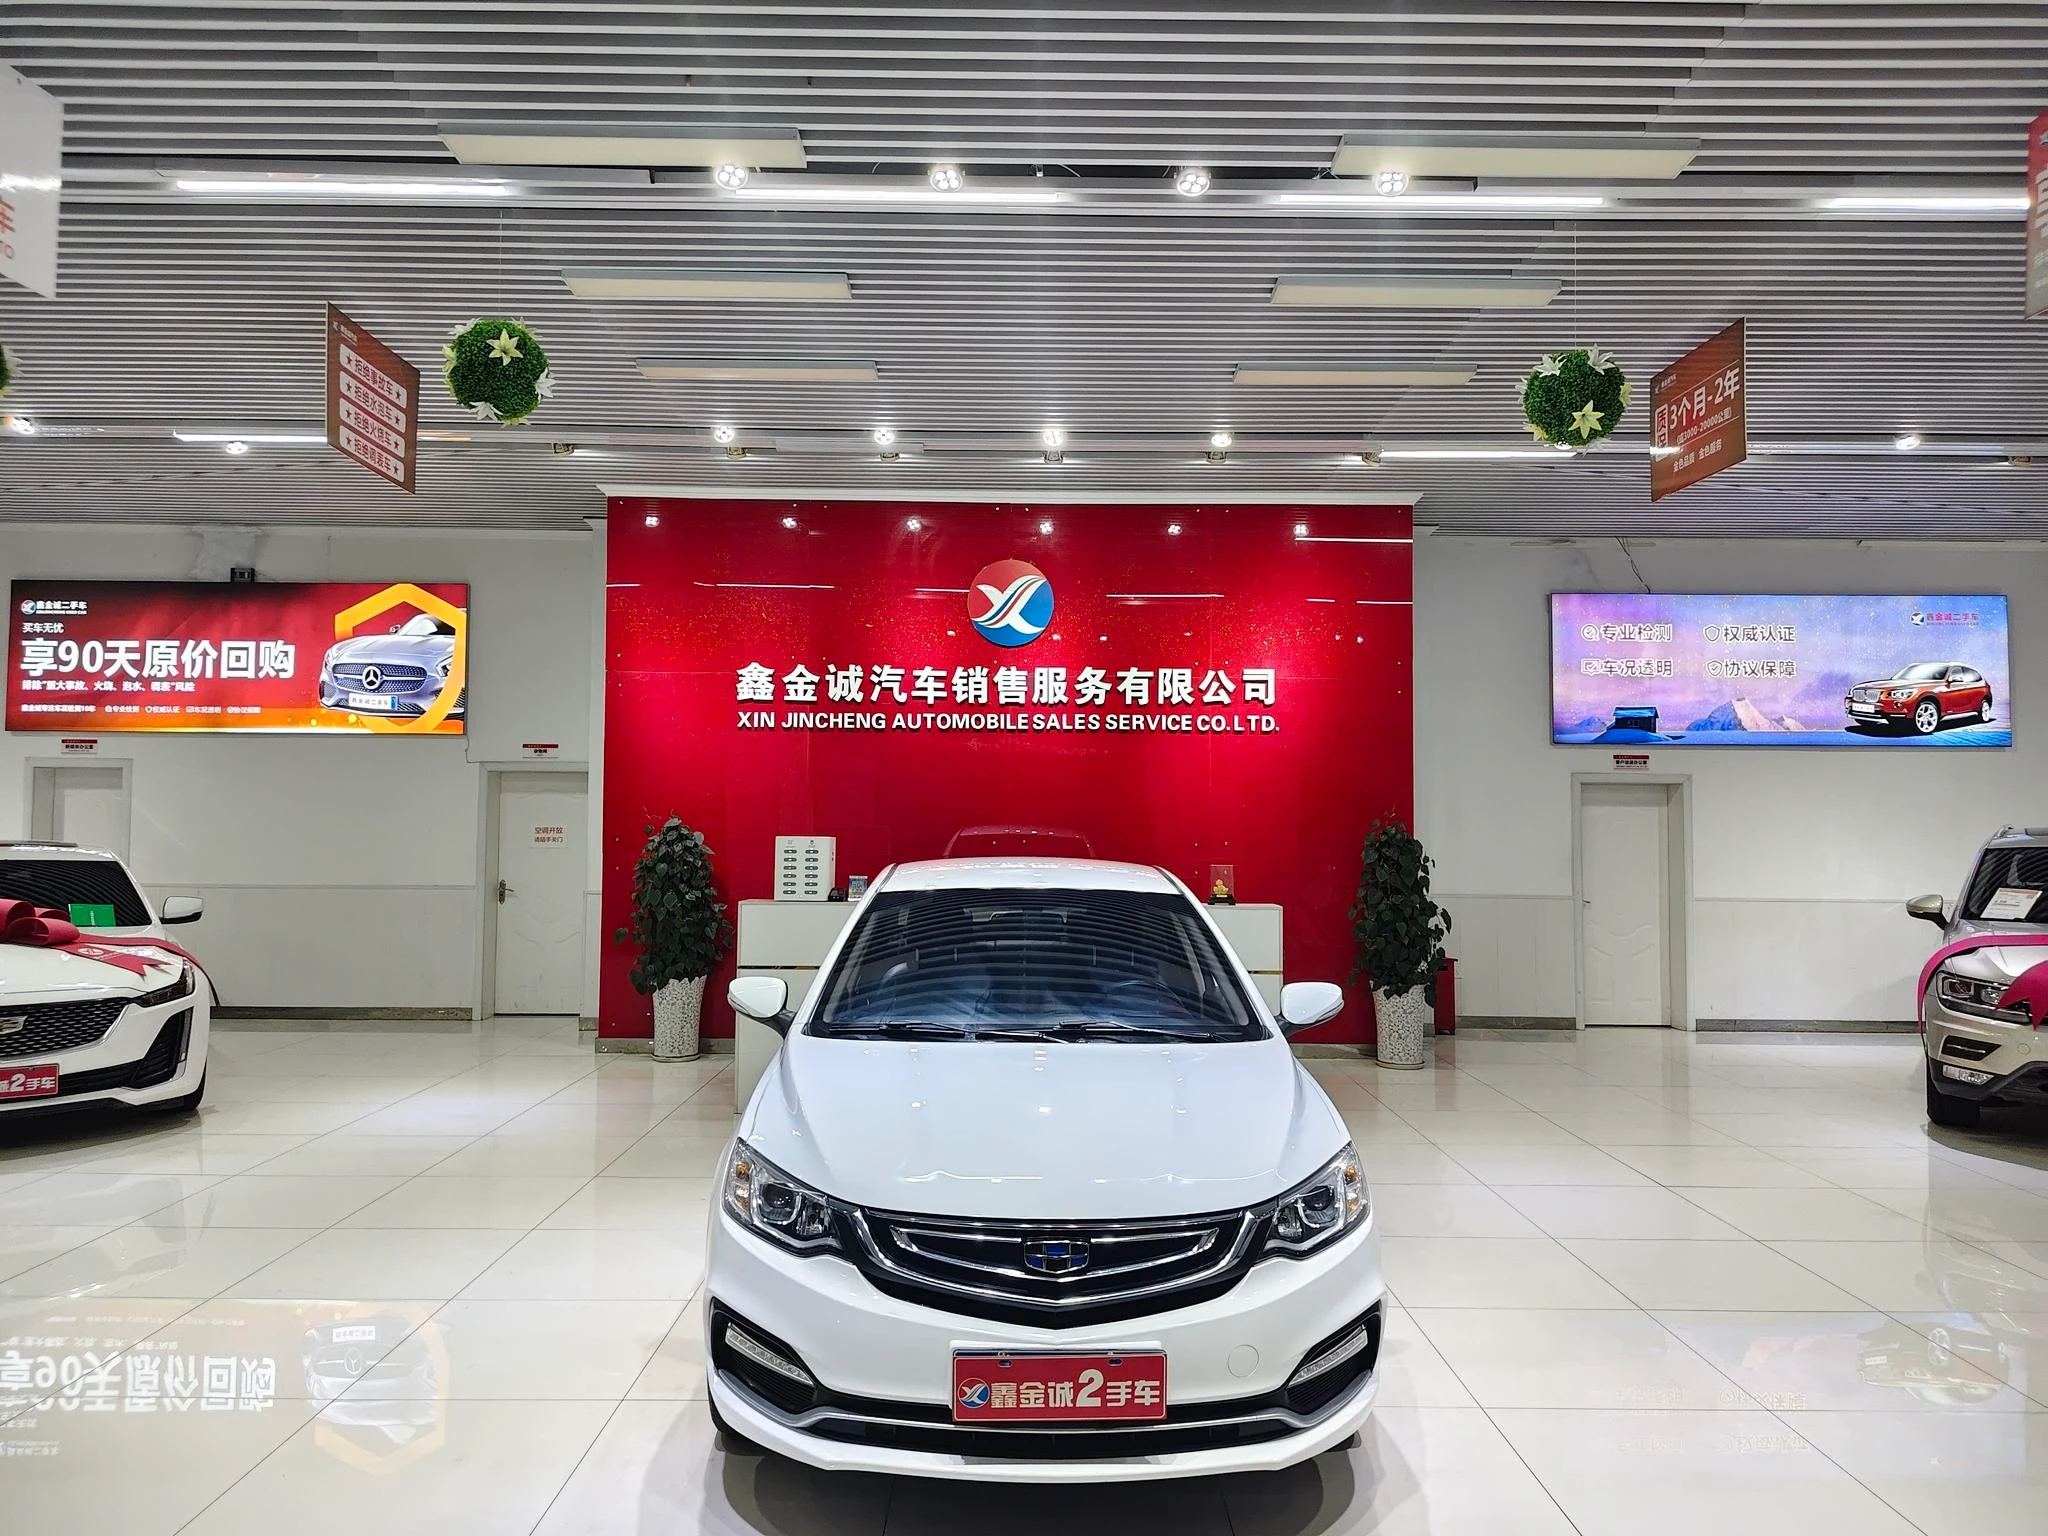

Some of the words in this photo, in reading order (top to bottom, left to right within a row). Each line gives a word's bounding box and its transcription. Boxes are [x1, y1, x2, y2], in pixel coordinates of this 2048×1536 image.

[354, 357, 394, 397] 拒绝事故车
[354, 384, 393, 421] 拒绝水泡车
[1670, 367, 1740, 429] 3个月-2年
[22, 622, 65, 633] 买车无忧
[1601, 624, 1673, 642] 专业检测
[1723, 625, 1796, 643] 权威认证
[21, 638, 296, 679] 享90天原价回购
[1602, 659, 1673, 677] 车况透明
[1723, 660, 1797, 678] 协议保障
[736, 661, 1277, 706] 鑫金诚汽车销售服务有限公司
[736, 711, 775, 729] XIN
[781, 712, 887, 730] JINCHENG
[892, 712, 1029, 731] AUTOMOBILE
[1032, 713, 1101, 731] SALES
[1105, 714, 1193, 732] SERVICE
[990, 1368, 1161, 1408] 鑫金诚2手车
